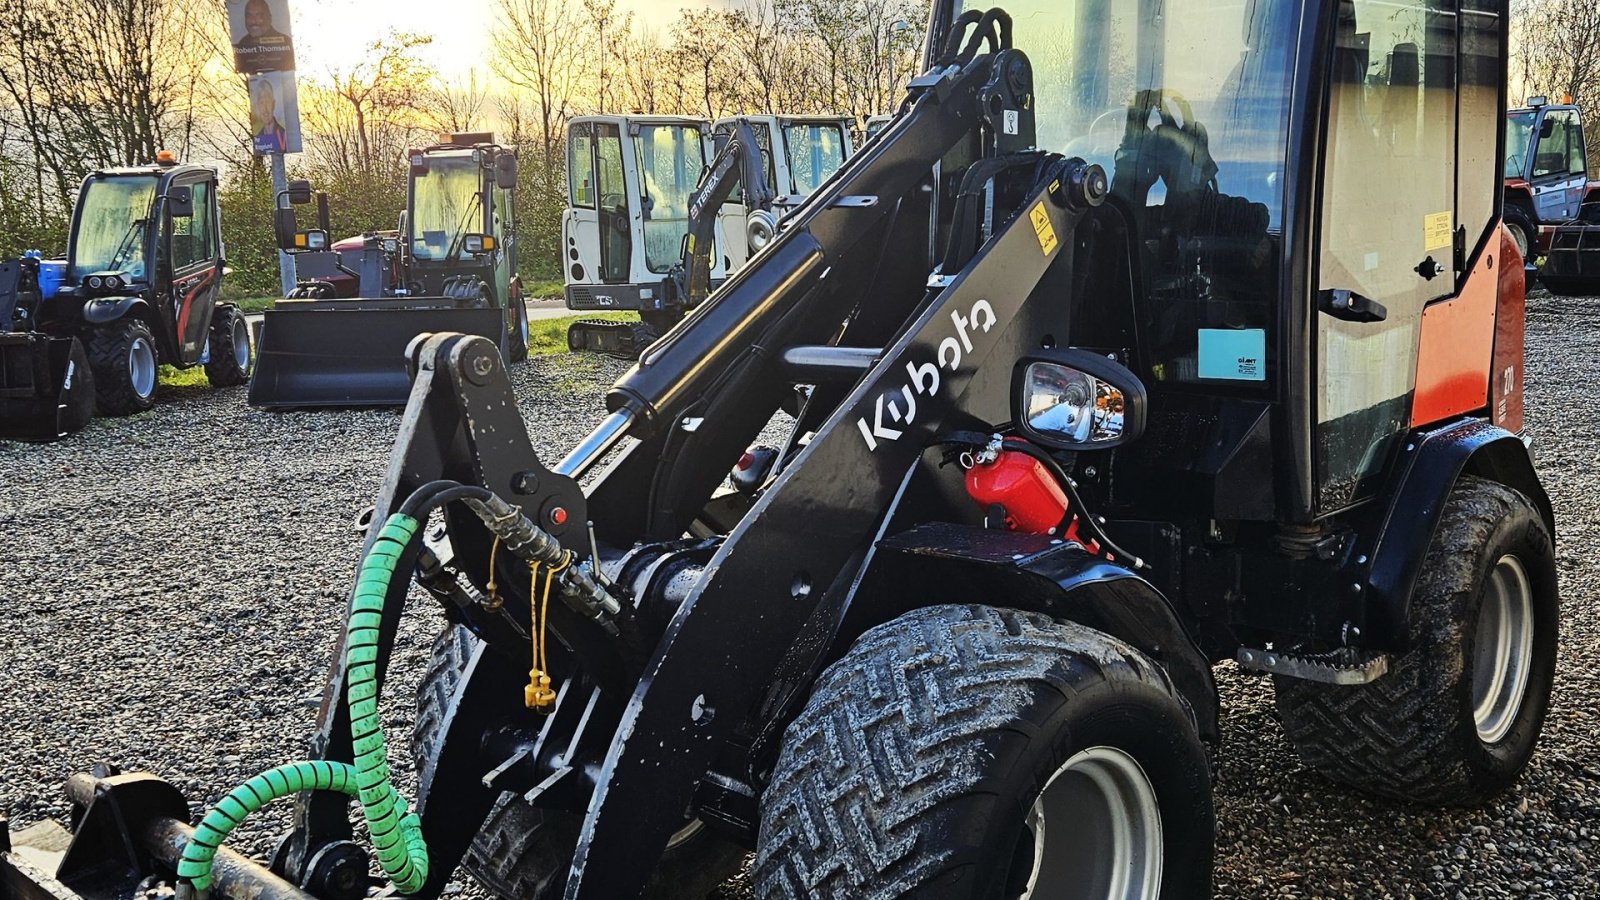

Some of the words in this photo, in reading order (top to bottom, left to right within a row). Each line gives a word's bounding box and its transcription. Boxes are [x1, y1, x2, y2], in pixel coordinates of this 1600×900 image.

[258, 45, 291, 53] Thomsen
[696, 171, 719, 208] TEREX
[857, 299, 997, 452] Kubota
